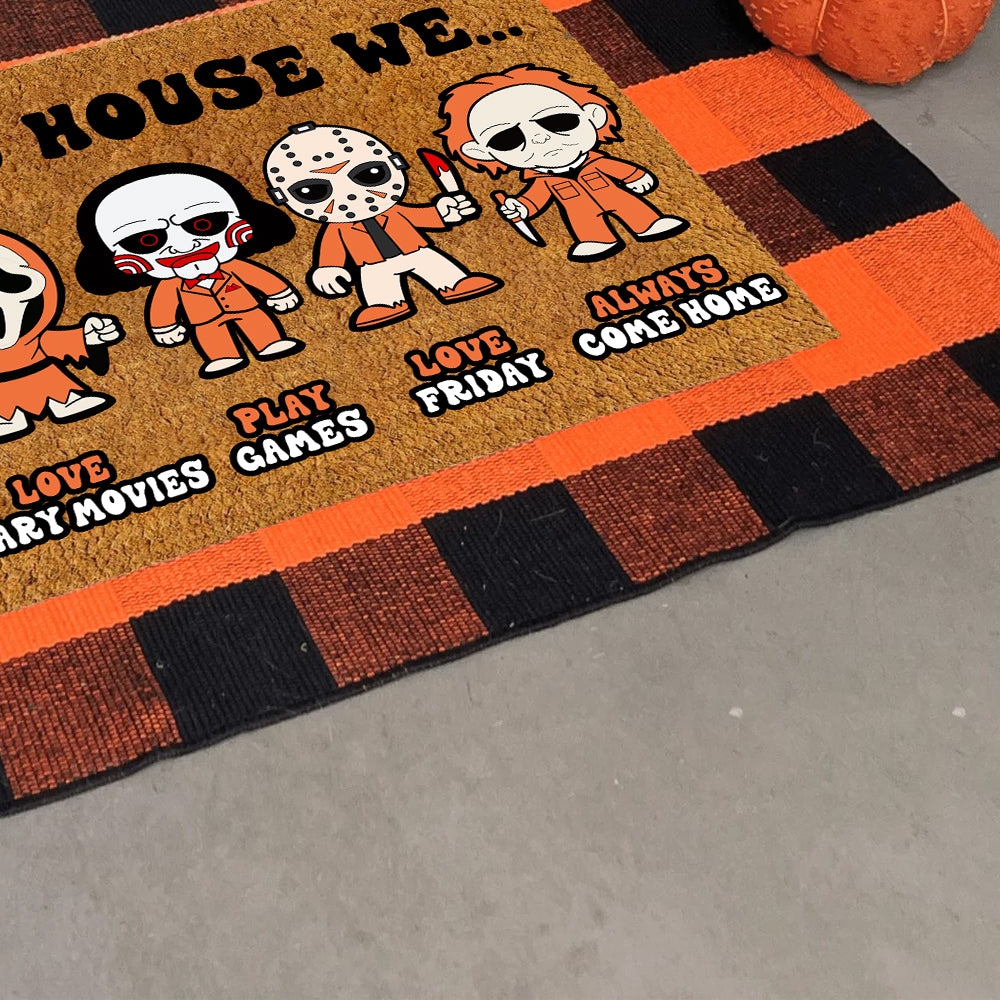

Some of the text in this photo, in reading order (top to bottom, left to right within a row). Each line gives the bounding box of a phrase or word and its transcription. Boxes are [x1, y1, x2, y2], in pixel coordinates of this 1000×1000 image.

[20, 44, 325, 160] HOUSE
[329, 6, 524, 73] WE...
[577, 276, 783, 358] COME HOME
[590, 257, 723, 319] ALWAYS
[410, 328, 512, 378] LOVE
[414, 351, 549, 414] FRIDAY
[232, 383, 331, 436] PLAY
[235, 407, 369, 473] GAMES
[11, 454, 111, 506] LOVE
[71, 458, 211, 528] MOVIES
